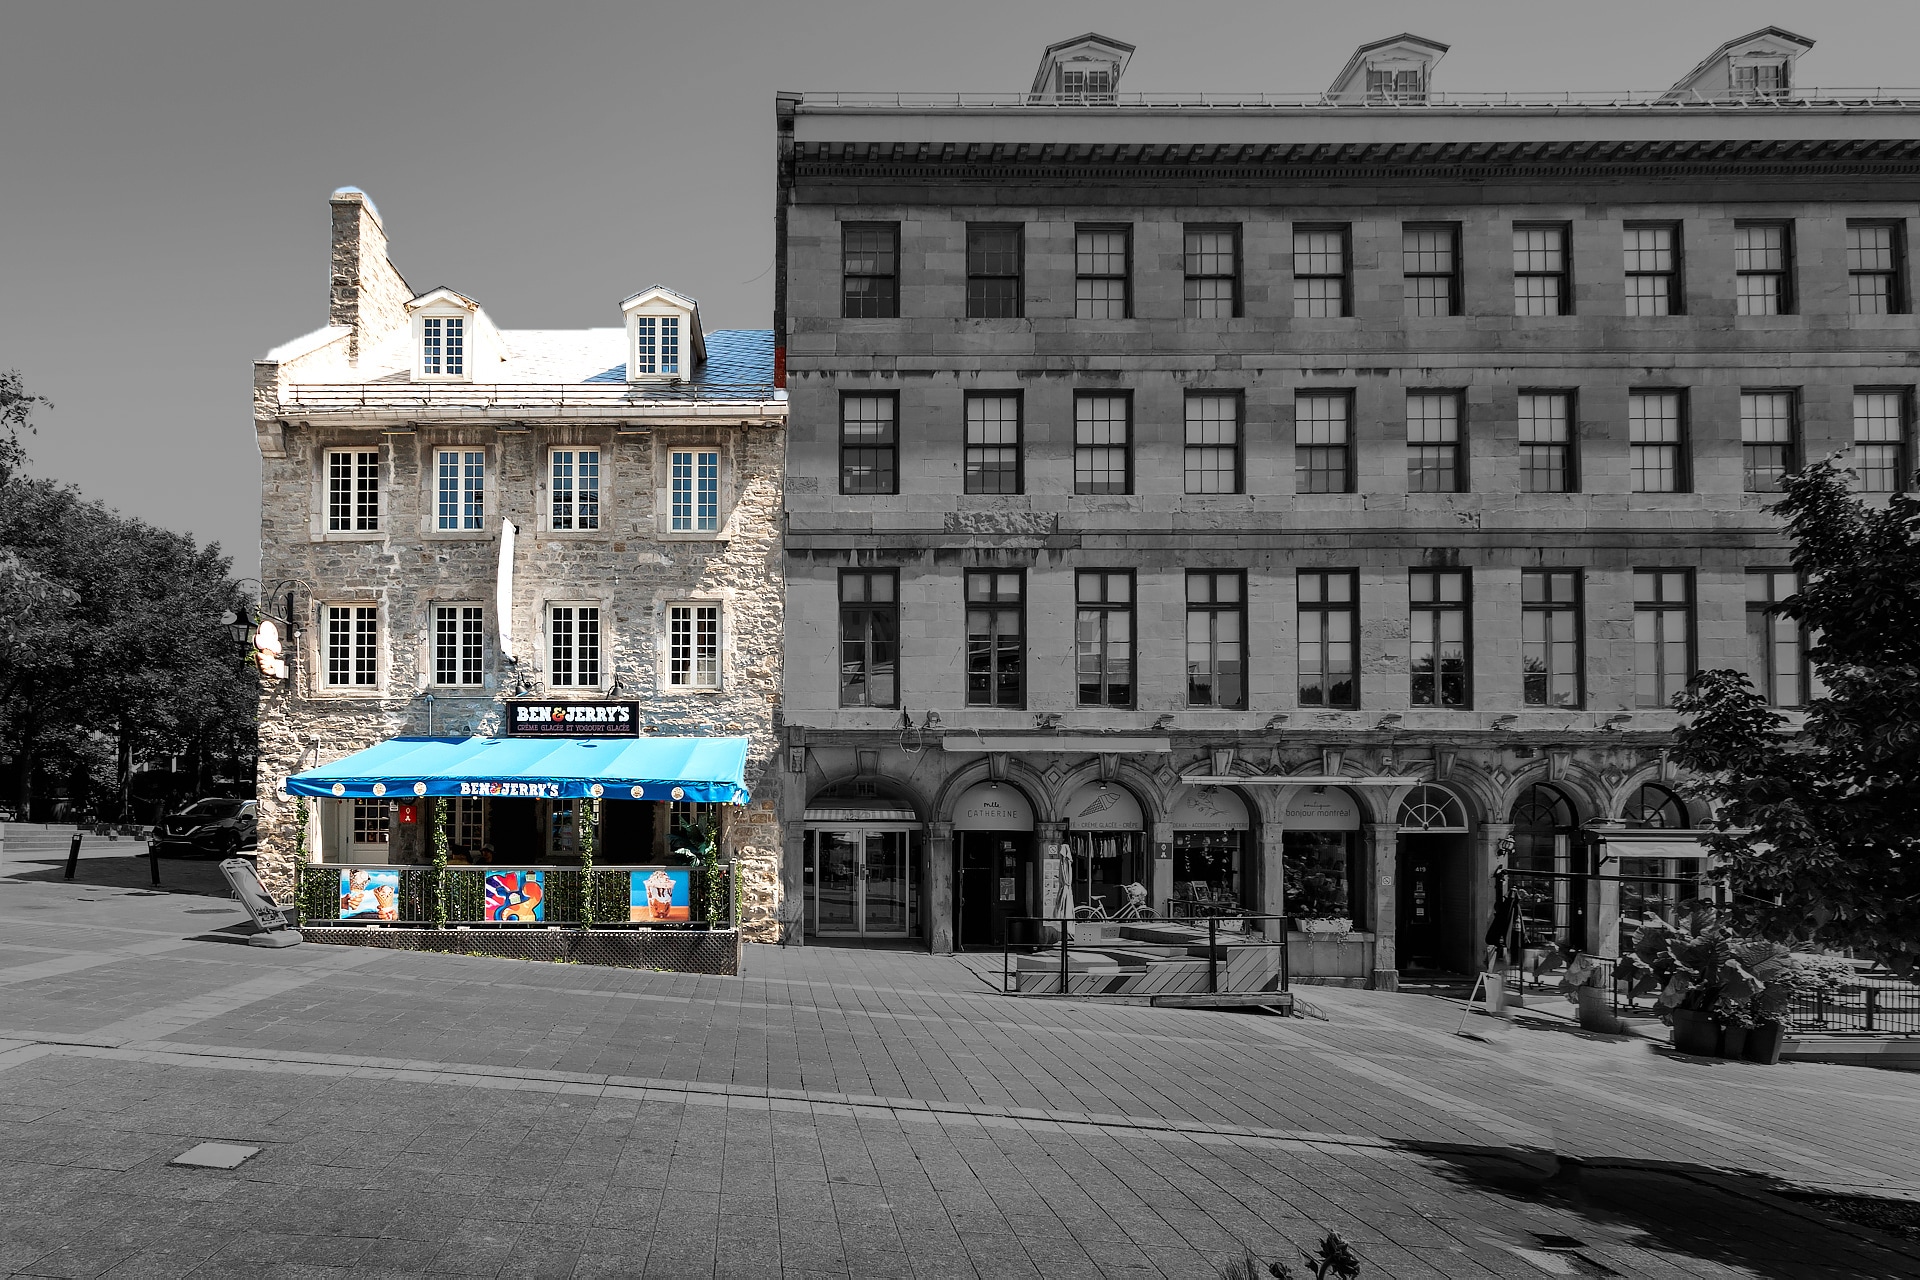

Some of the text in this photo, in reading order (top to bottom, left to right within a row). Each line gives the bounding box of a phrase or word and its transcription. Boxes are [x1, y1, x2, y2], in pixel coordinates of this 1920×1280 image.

[541, 723, 564, 732] GLACÉE
[566, 724, 574, 732] ET
[575, 724, 604, 732] YOGOURT
[606, 723, 630, 732] GLACÉE
[967, 810, 1018, 818] CATHERINE
[1285, 809, 1351, 818] bonjour montréal
